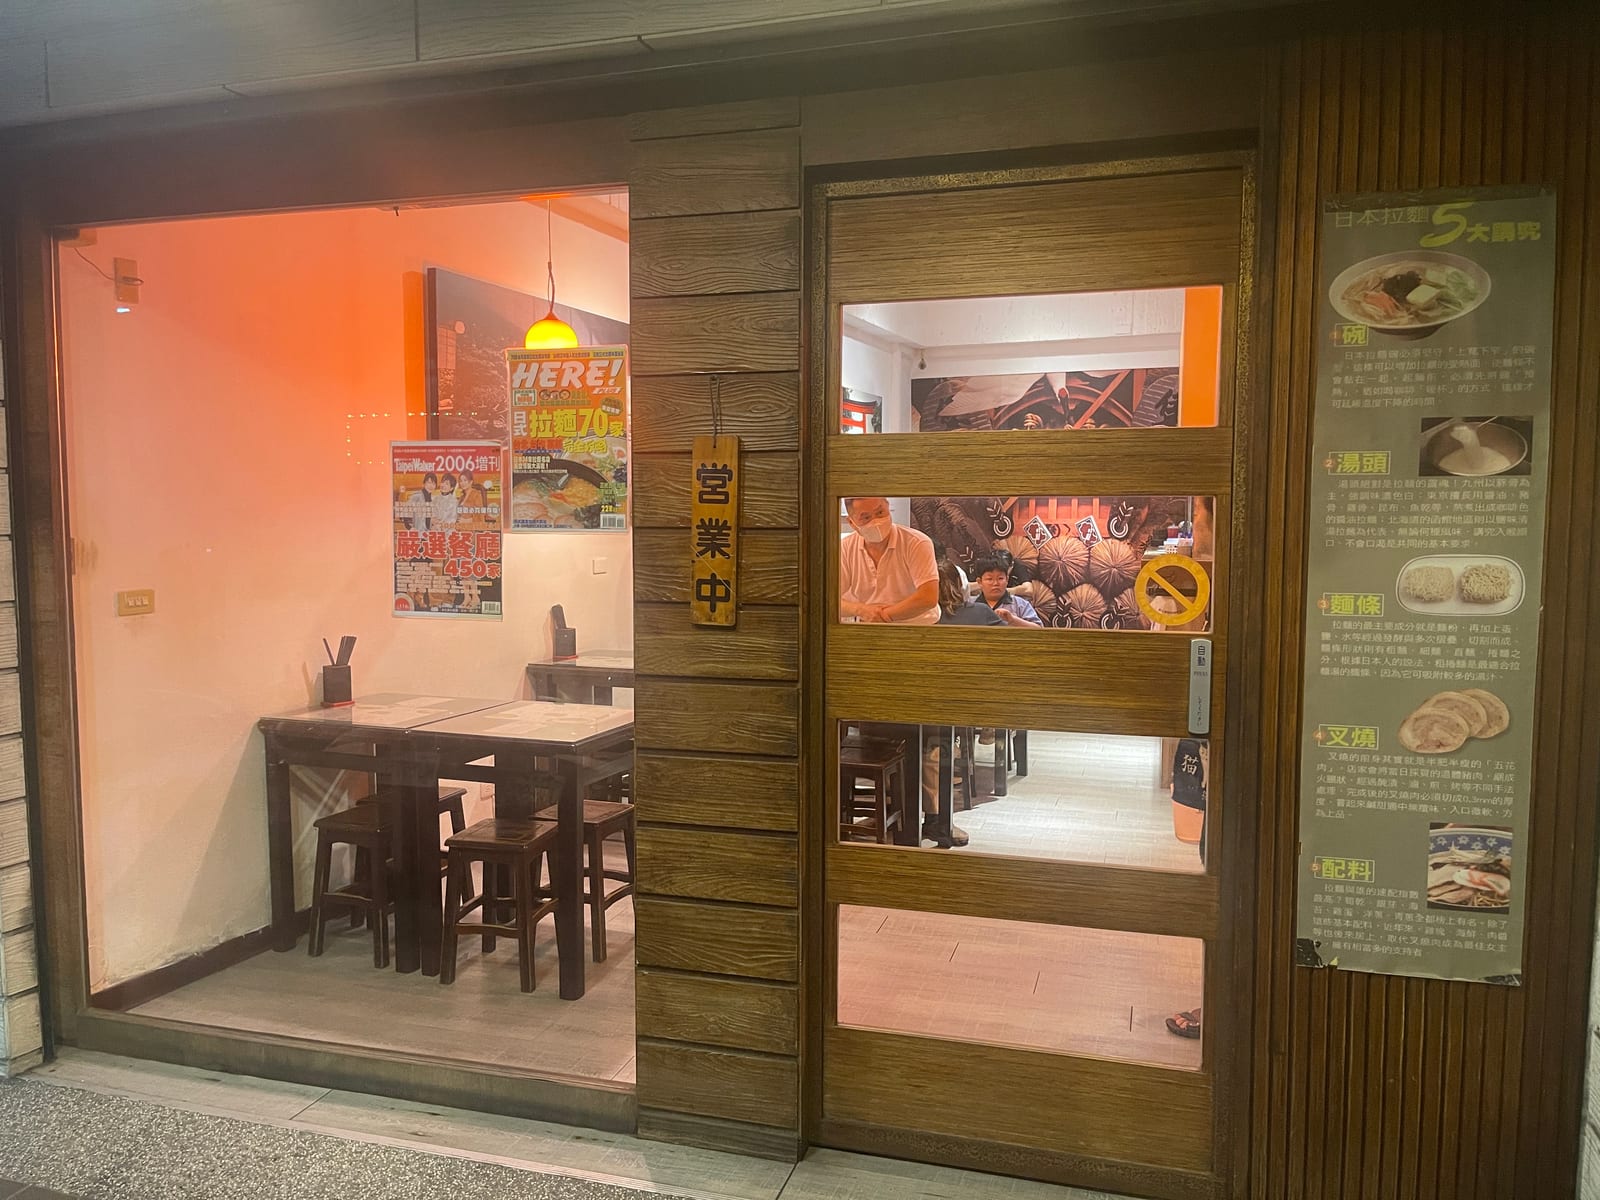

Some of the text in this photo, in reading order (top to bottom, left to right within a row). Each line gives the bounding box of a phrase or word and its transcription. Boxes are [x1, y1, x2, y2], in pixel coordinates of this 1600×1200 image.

[1343, 323, 1367, 345] 碗
[511, 359, 624, 389] HERE!
[435, 455, 500, 473] 2006增刊
[1336, 453, 1388, 473] 湯頭
[396, 530, 501, 560] 嚴選餐廳
[444, 559, 501, 579] 450家
[1330, 594, 1381, 614] 麵條
[1326, 727, 1376, 748] 叉燒
[1322, 859, 1371, 881] 配料
